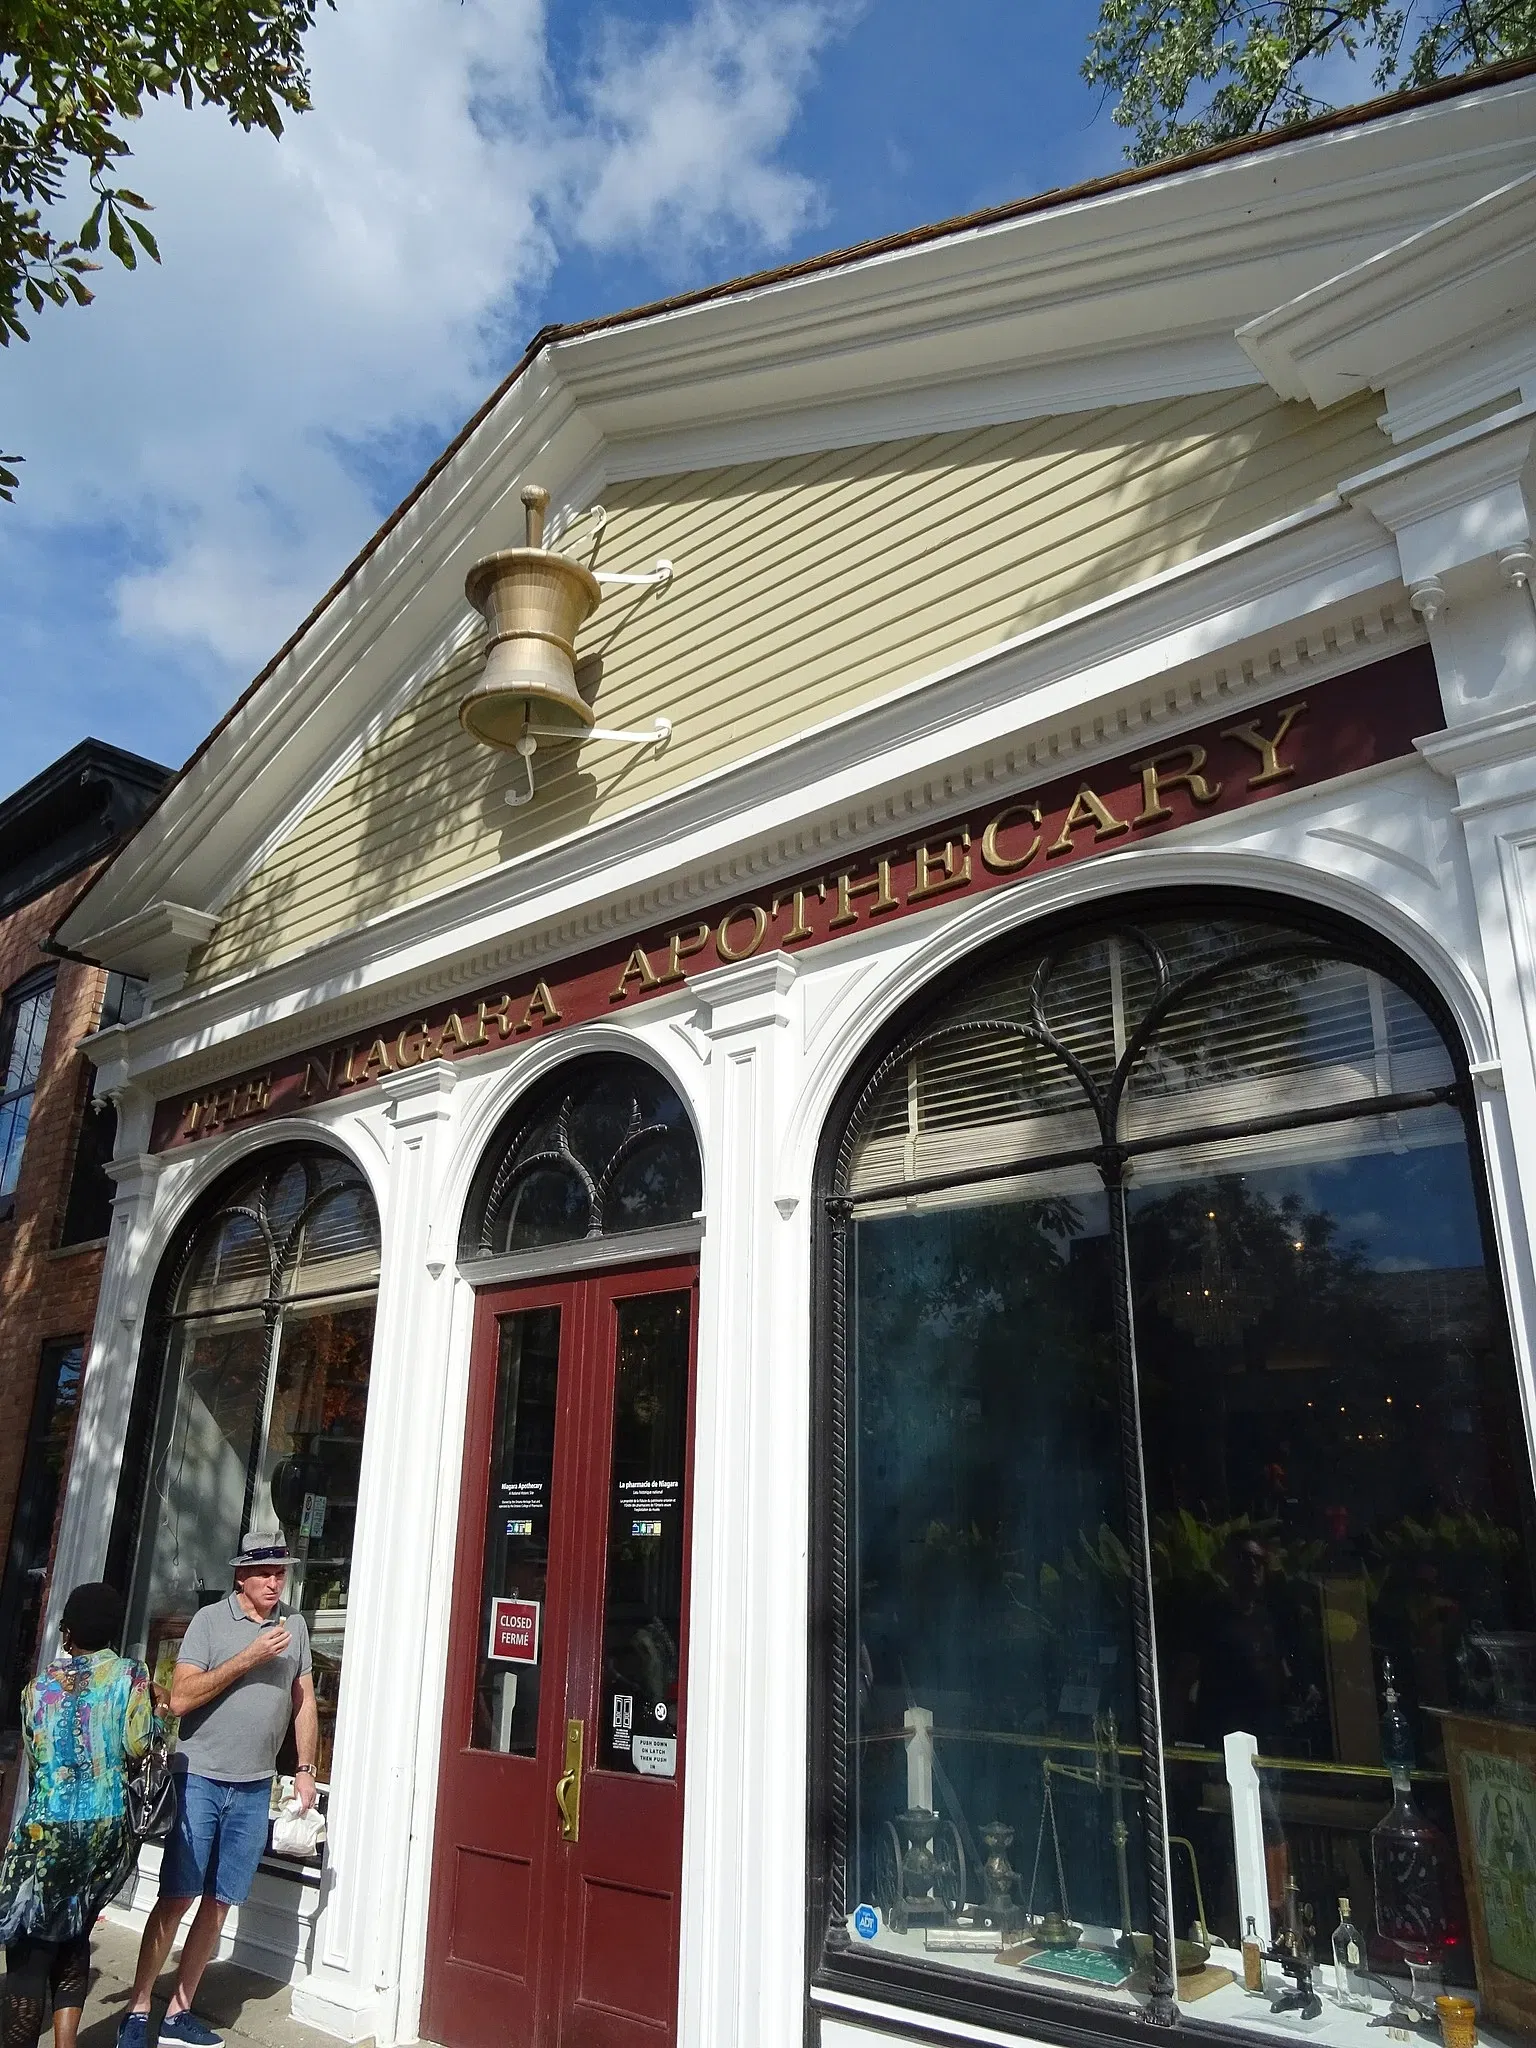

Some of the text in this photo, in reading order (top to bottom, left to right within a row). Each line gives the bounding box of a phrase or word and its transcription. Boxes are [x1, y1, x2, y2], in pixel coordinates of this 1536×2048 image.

[182, 701, 1309, 1138] THE NIAGARA APOTHECARY
[501, 1482, 543, 1491] Niagara Apothecary
[625, 1480, 651, 1489] pharmacie
[651, 1480, 658, 1488] de
[659, 1480, 679, 1489] Niagara
[500, 1615, 532, 1629] CLOSED
[501, 1632, 529, 1646] FERMÉ
[859, 1916, 875, 1929] ADT
